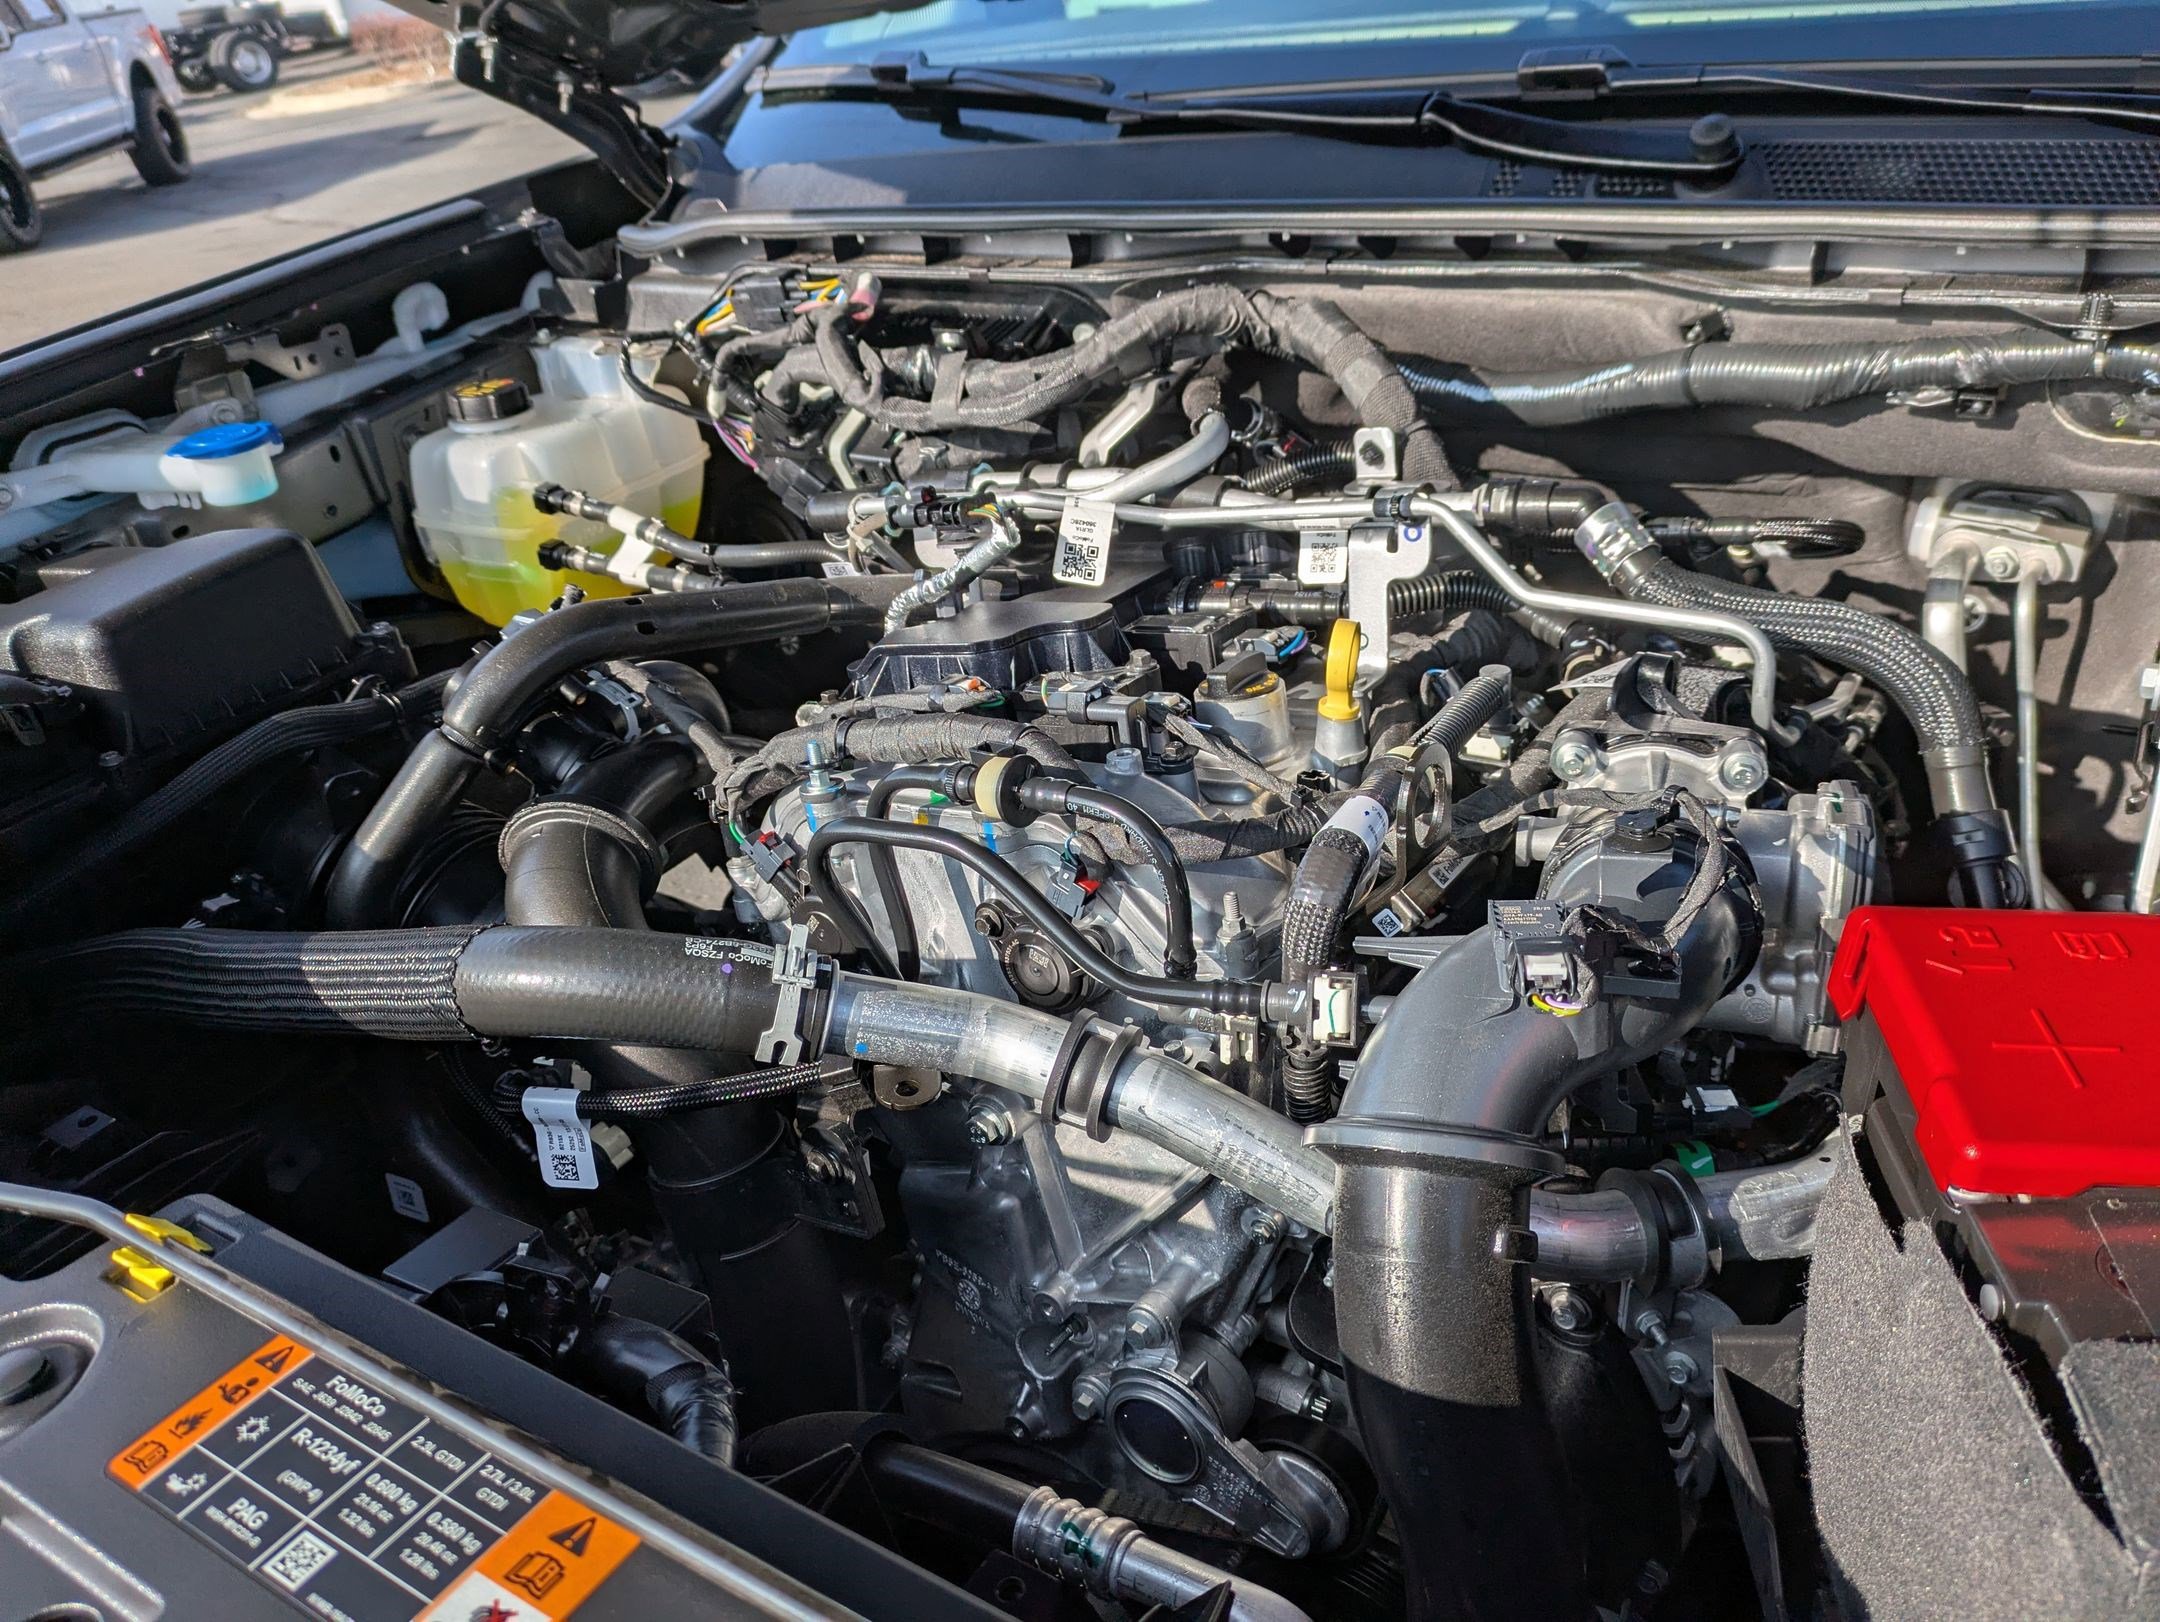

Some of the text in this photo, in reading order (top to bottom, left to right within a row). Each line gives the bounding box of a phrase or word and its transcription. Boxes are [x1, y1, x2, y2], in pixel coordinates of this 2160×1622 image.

[684, 947, 775, 969] FoMoCo FZSQA
[291, 1377, 316, 1395] SAE
[325, 1374, 386, 1418] FoMoCo
[290, 1427, 362, 1476] R-1234yf
[409, 1435, 467, 1473] 2.3L GTDI
[364, 1472, 419, 1516] 0.600 kg
[478, 1464, 507, 1488] 2.7L
[226, 1497, 269, 1531] PAG
[475, 1486, 511, 1511] GTDI
[425, 1510, 484, 1556] 0.580 kg
